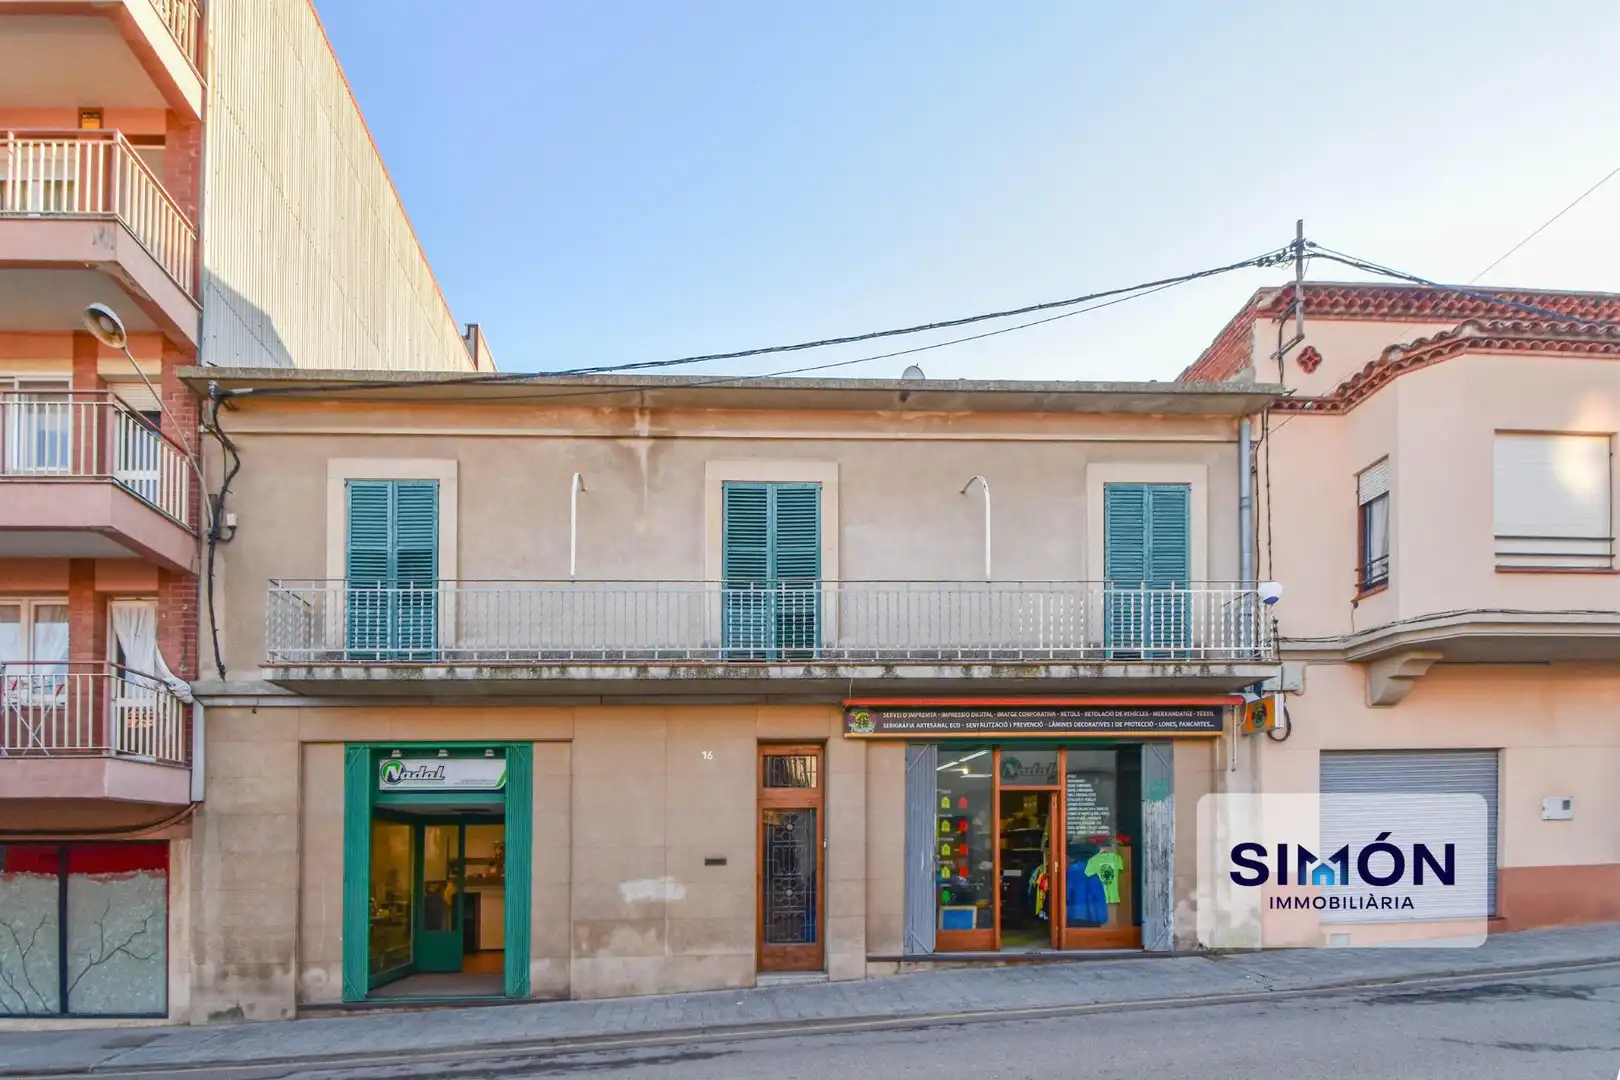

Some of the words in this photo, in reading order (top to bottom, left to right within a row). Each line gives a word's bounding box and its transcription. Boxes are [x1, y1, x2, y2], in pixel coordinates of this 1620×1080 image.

[1124, 720, 1154, 728] PROTECCIÓ
[1158, 721, 1178, 729] LONES,
[701, 750, 714, 760] 16
[382, 761, 446, 783] Nadal
